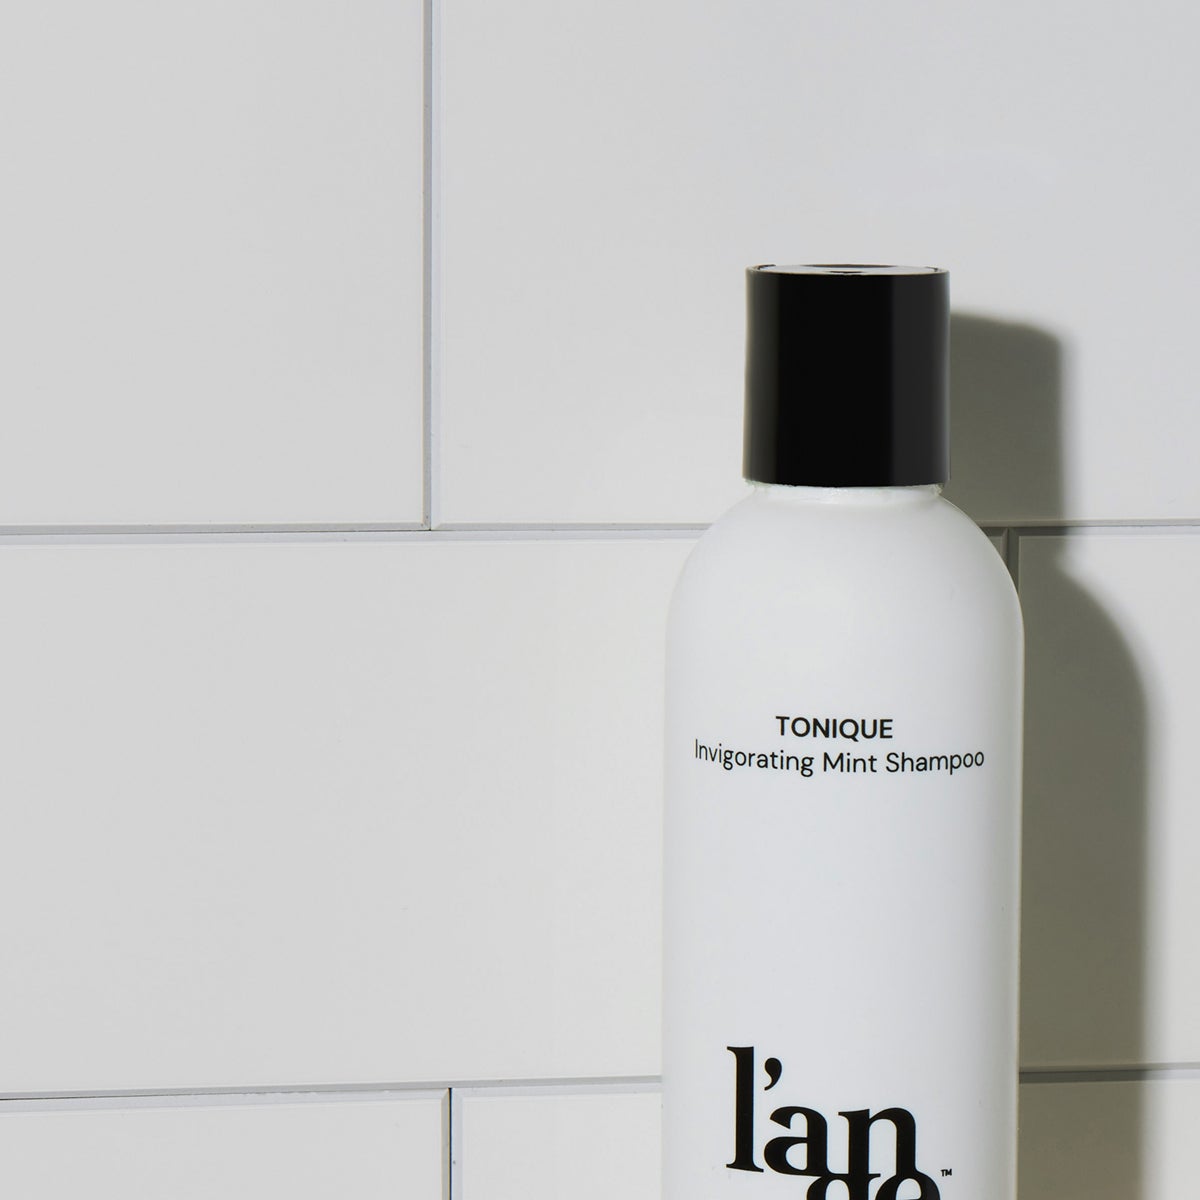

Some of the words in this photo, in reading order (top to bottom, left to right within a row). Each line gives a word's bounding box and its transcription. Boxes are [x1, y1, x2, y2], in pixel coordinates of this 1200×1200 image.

[775, 715, 894, 743] TONIQUE
[694, 738, 815, 778] Invigorating
[822, 751, 878, 774] Mint
[885, 751, 985, 776] Shampoo
